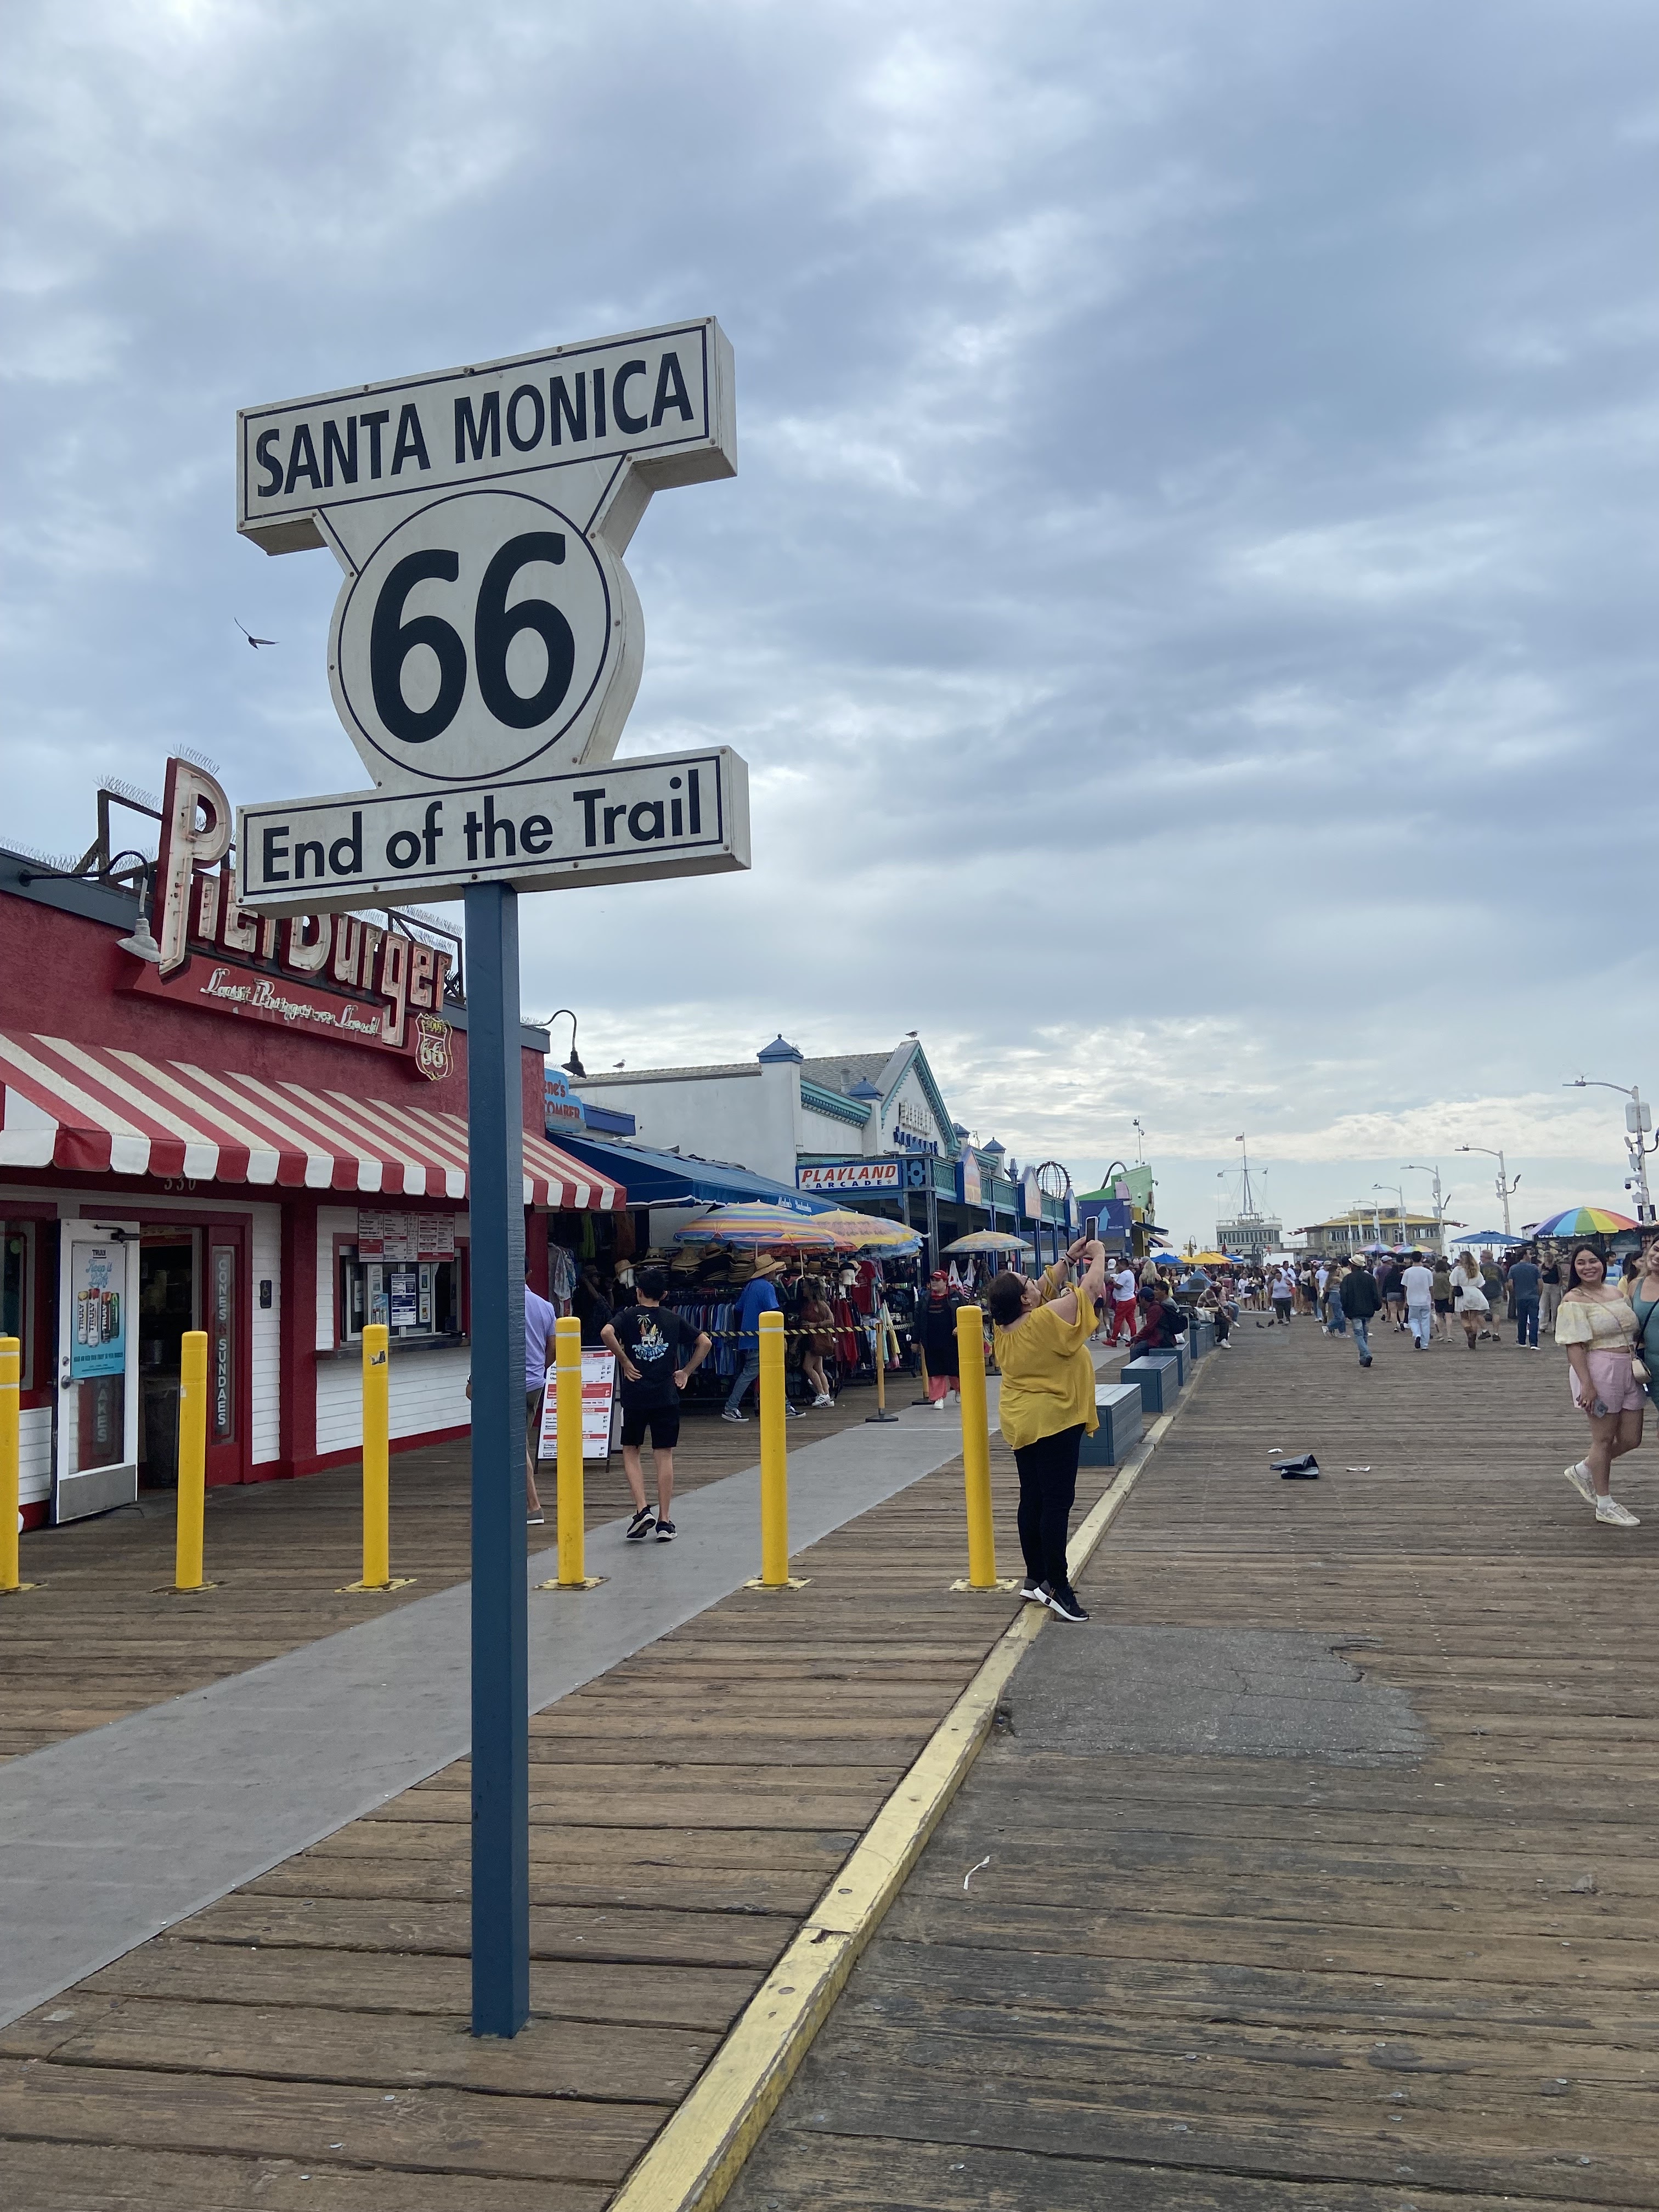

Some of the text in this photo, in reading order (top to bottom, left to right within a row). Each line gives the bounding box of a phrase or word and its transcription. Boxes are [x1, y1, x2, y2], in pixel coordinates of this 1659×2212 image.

[257, 351, 694, 497] SANTA MONICA
[370, 531, 575, 743] 66
[263, 769, 701, 882] End of the Trail
[420, 1038, 448, 1069] 66
[801, 1165, 896, 1183] PLAYLAND
[815, 1180, 882, 1189] ARCADE
[218, 1259, 227, 1321] CONES
[217, 1338, 227, 1426] SUNDAES
